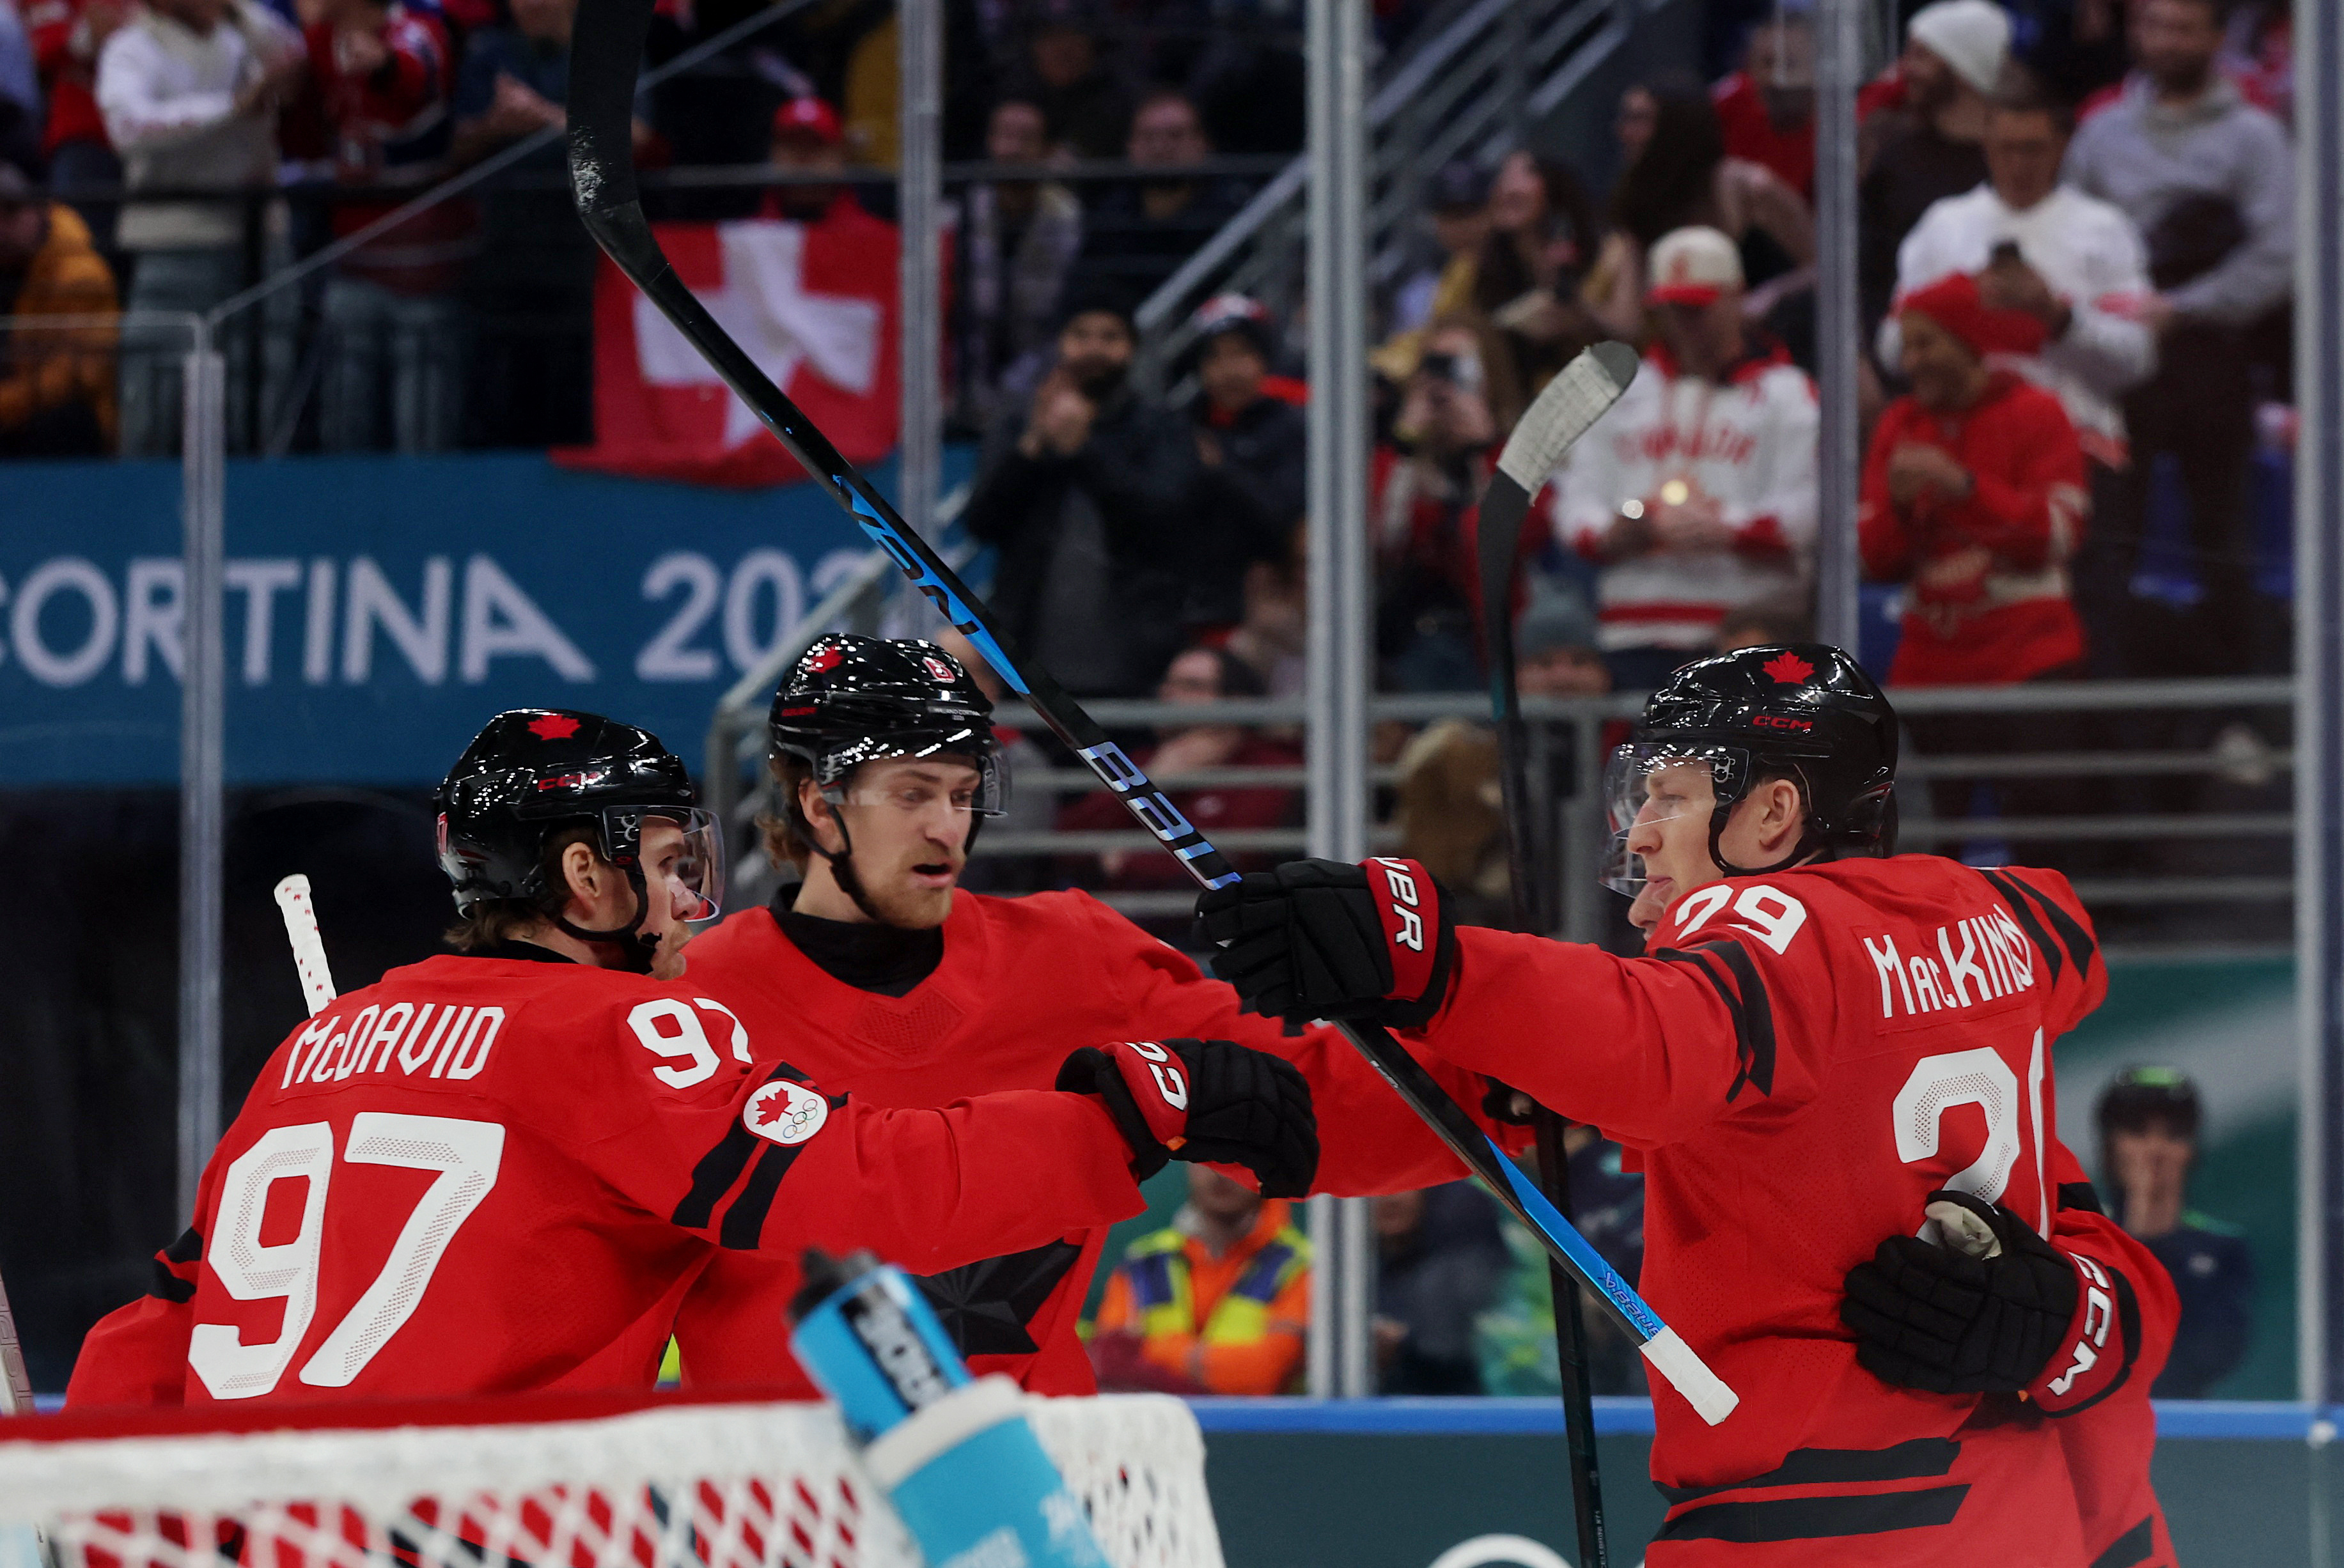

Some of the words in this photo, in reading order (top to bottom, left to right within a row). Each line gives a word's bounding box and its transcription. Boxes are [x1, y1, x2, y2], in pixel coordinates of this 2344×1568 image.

[0, 555, 596, 688] ORTINA
[1753, 715, 1813, 730] CCM
[1675, 884, 1807, 955] 29
[281, 1002, 506, 1089] McDAVID
[187, 1112, 506, 1400] 97
